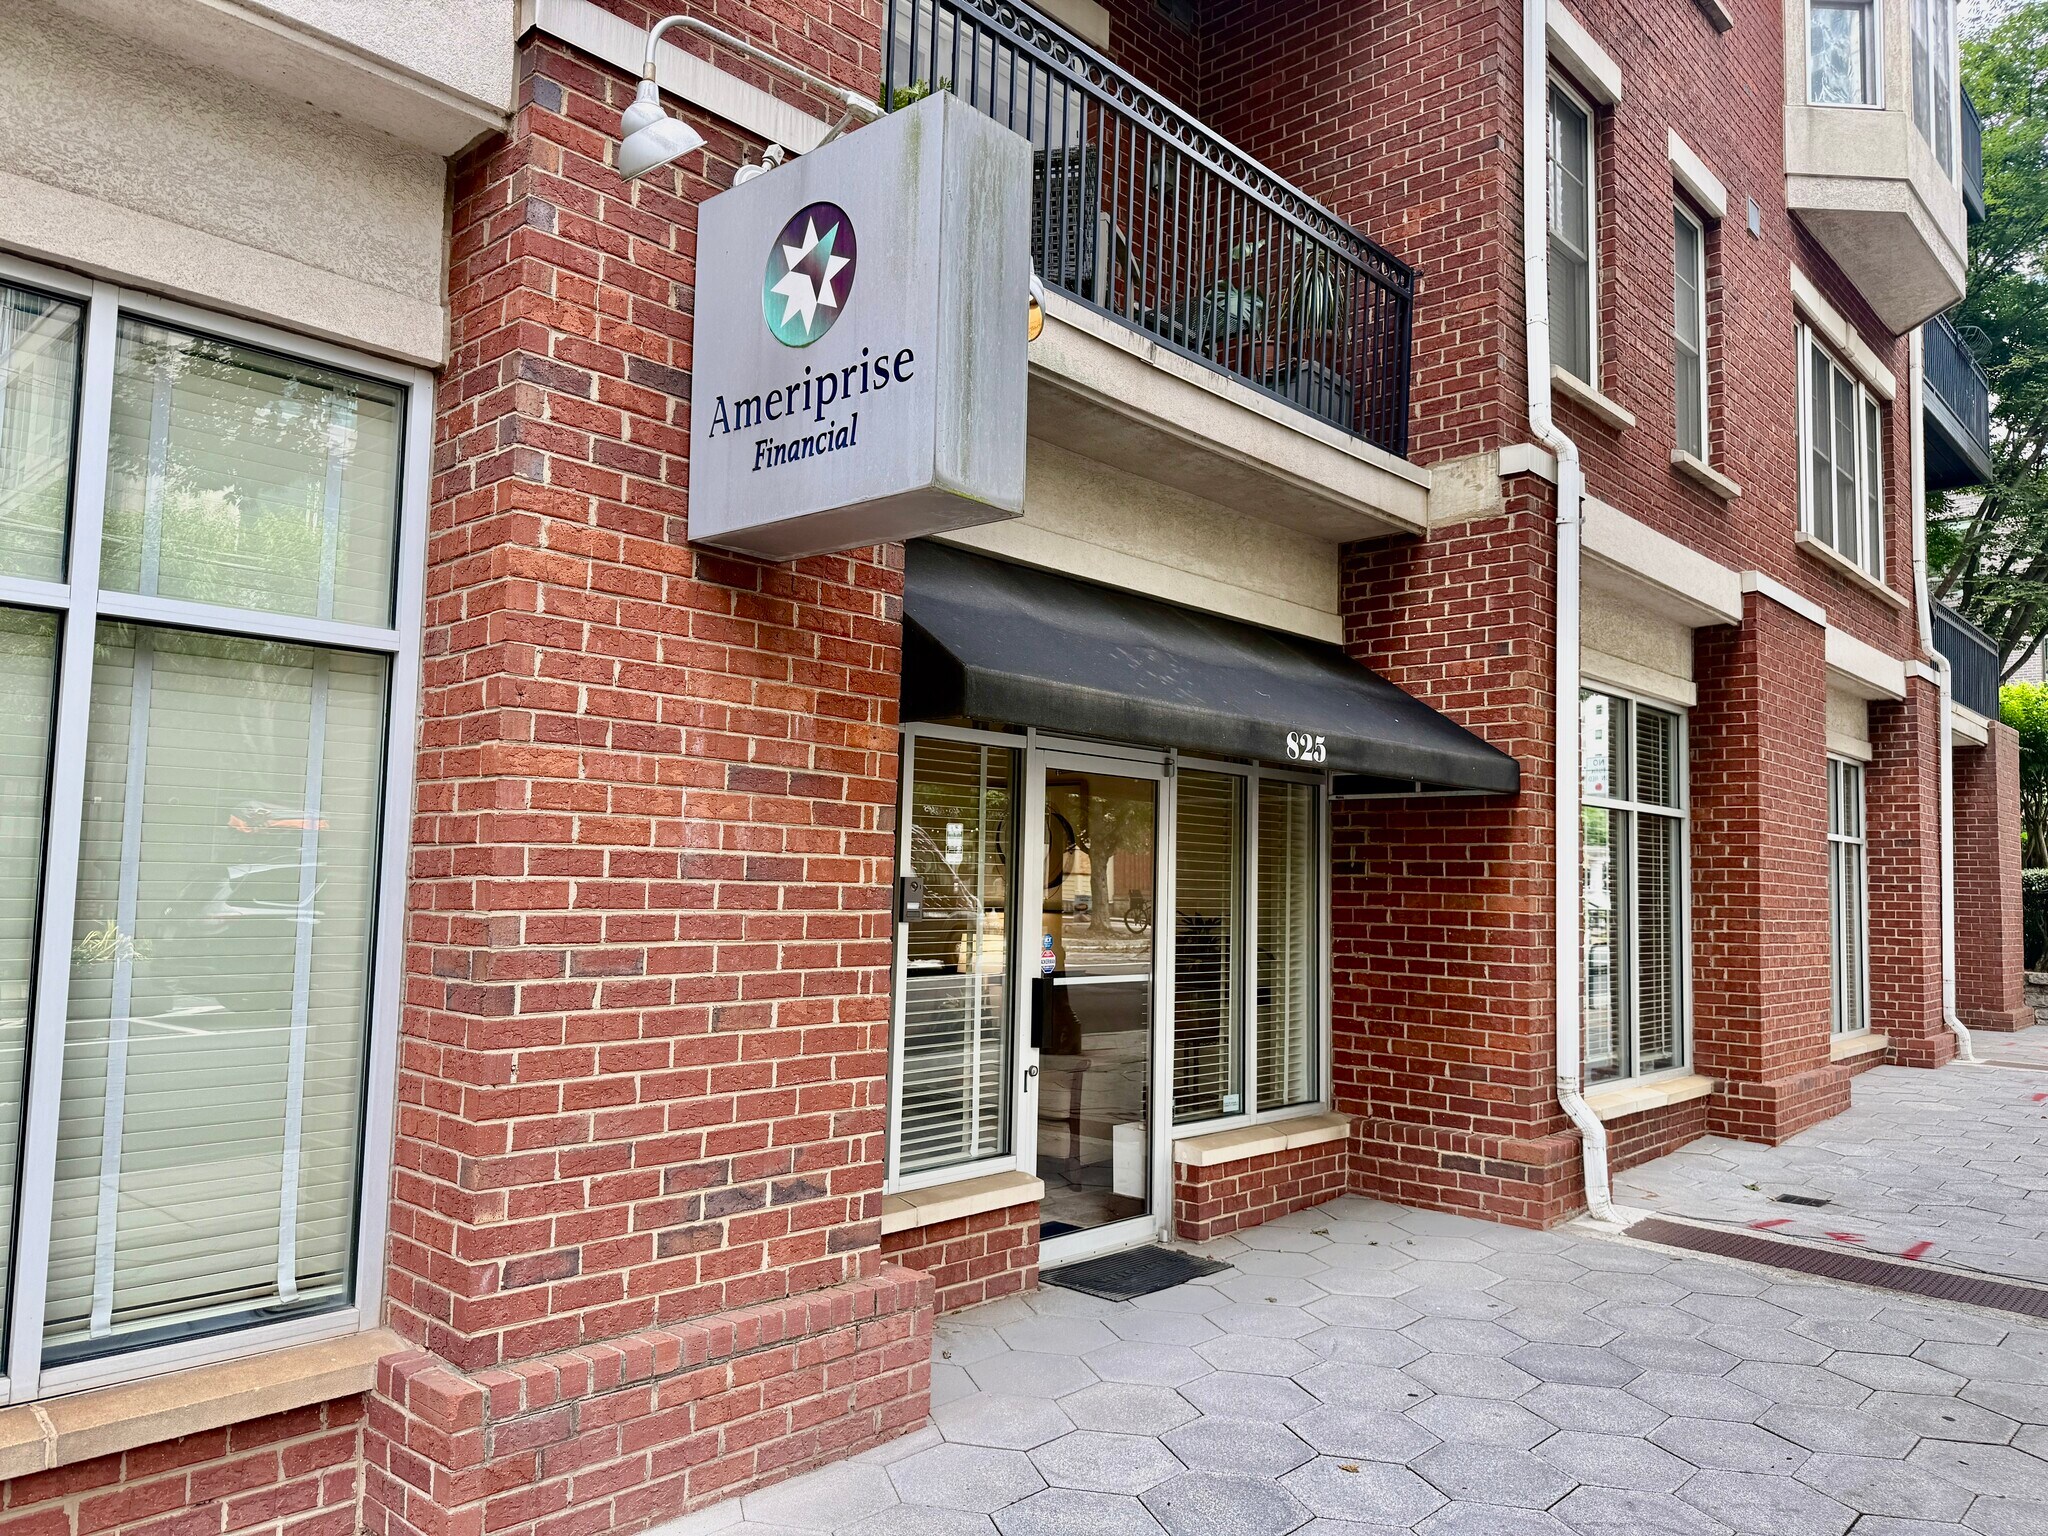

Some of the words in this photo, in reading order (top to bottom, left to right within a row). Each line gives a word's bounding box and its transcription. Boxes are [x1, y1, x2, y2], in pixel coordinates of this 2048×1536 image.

[709, 347, 914, 437] Ameriprise
[752, 412, 858, 471] Financial
[1286, 731, 1326, 762] 825
